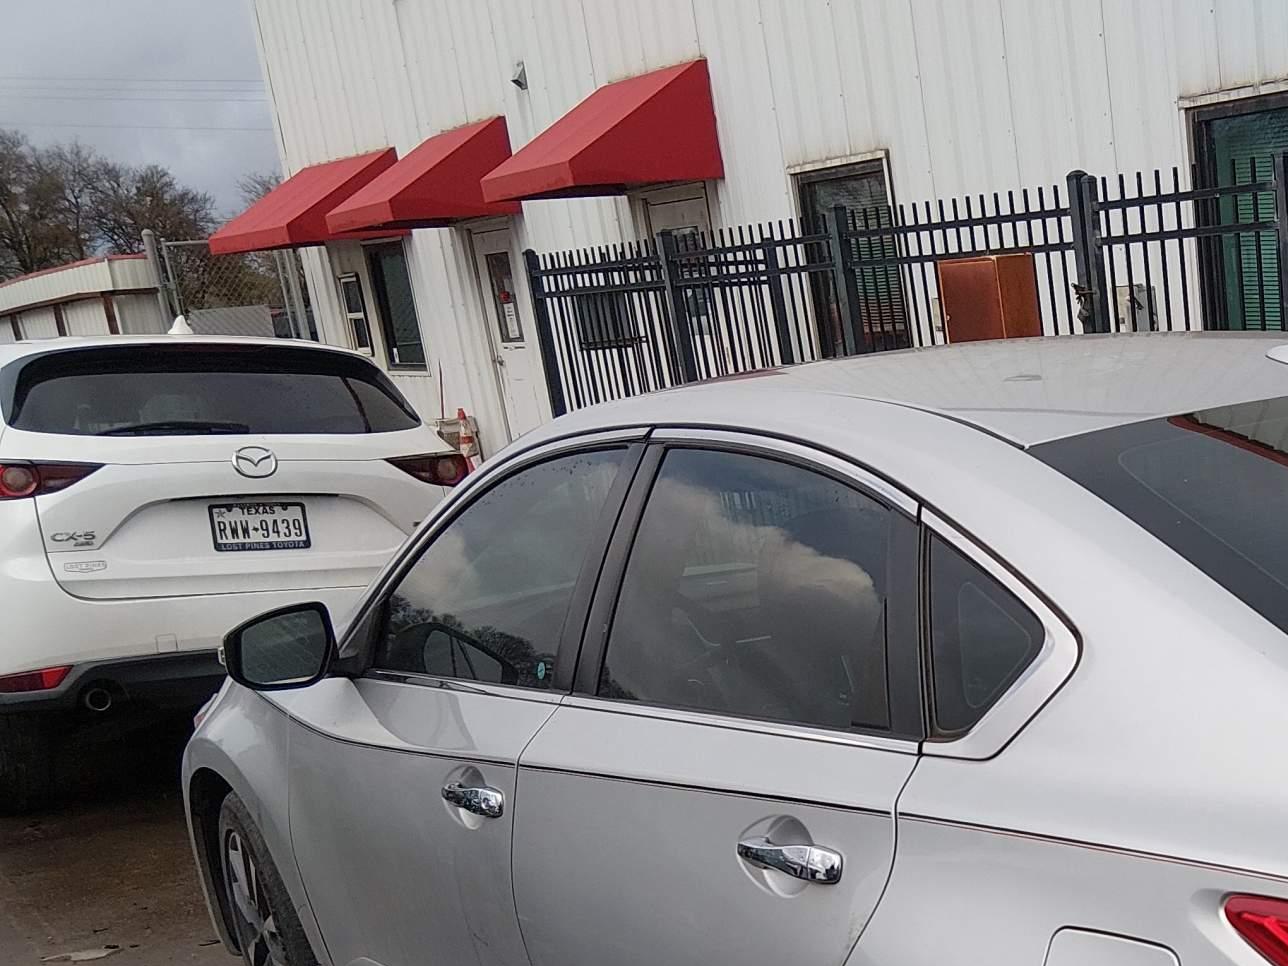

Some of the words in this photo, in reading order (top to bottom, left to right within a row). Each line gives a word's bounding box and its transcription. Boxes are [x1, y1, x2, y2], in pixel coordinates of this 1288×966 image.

[240, 504, 276, 516] TEXAS
[50, 530, 96, 543] CX-5
[221, 542, 243, 551] LOST
[245, 541, 270, 550] PINES
[272, 540, 305, 549] TOYOTA
